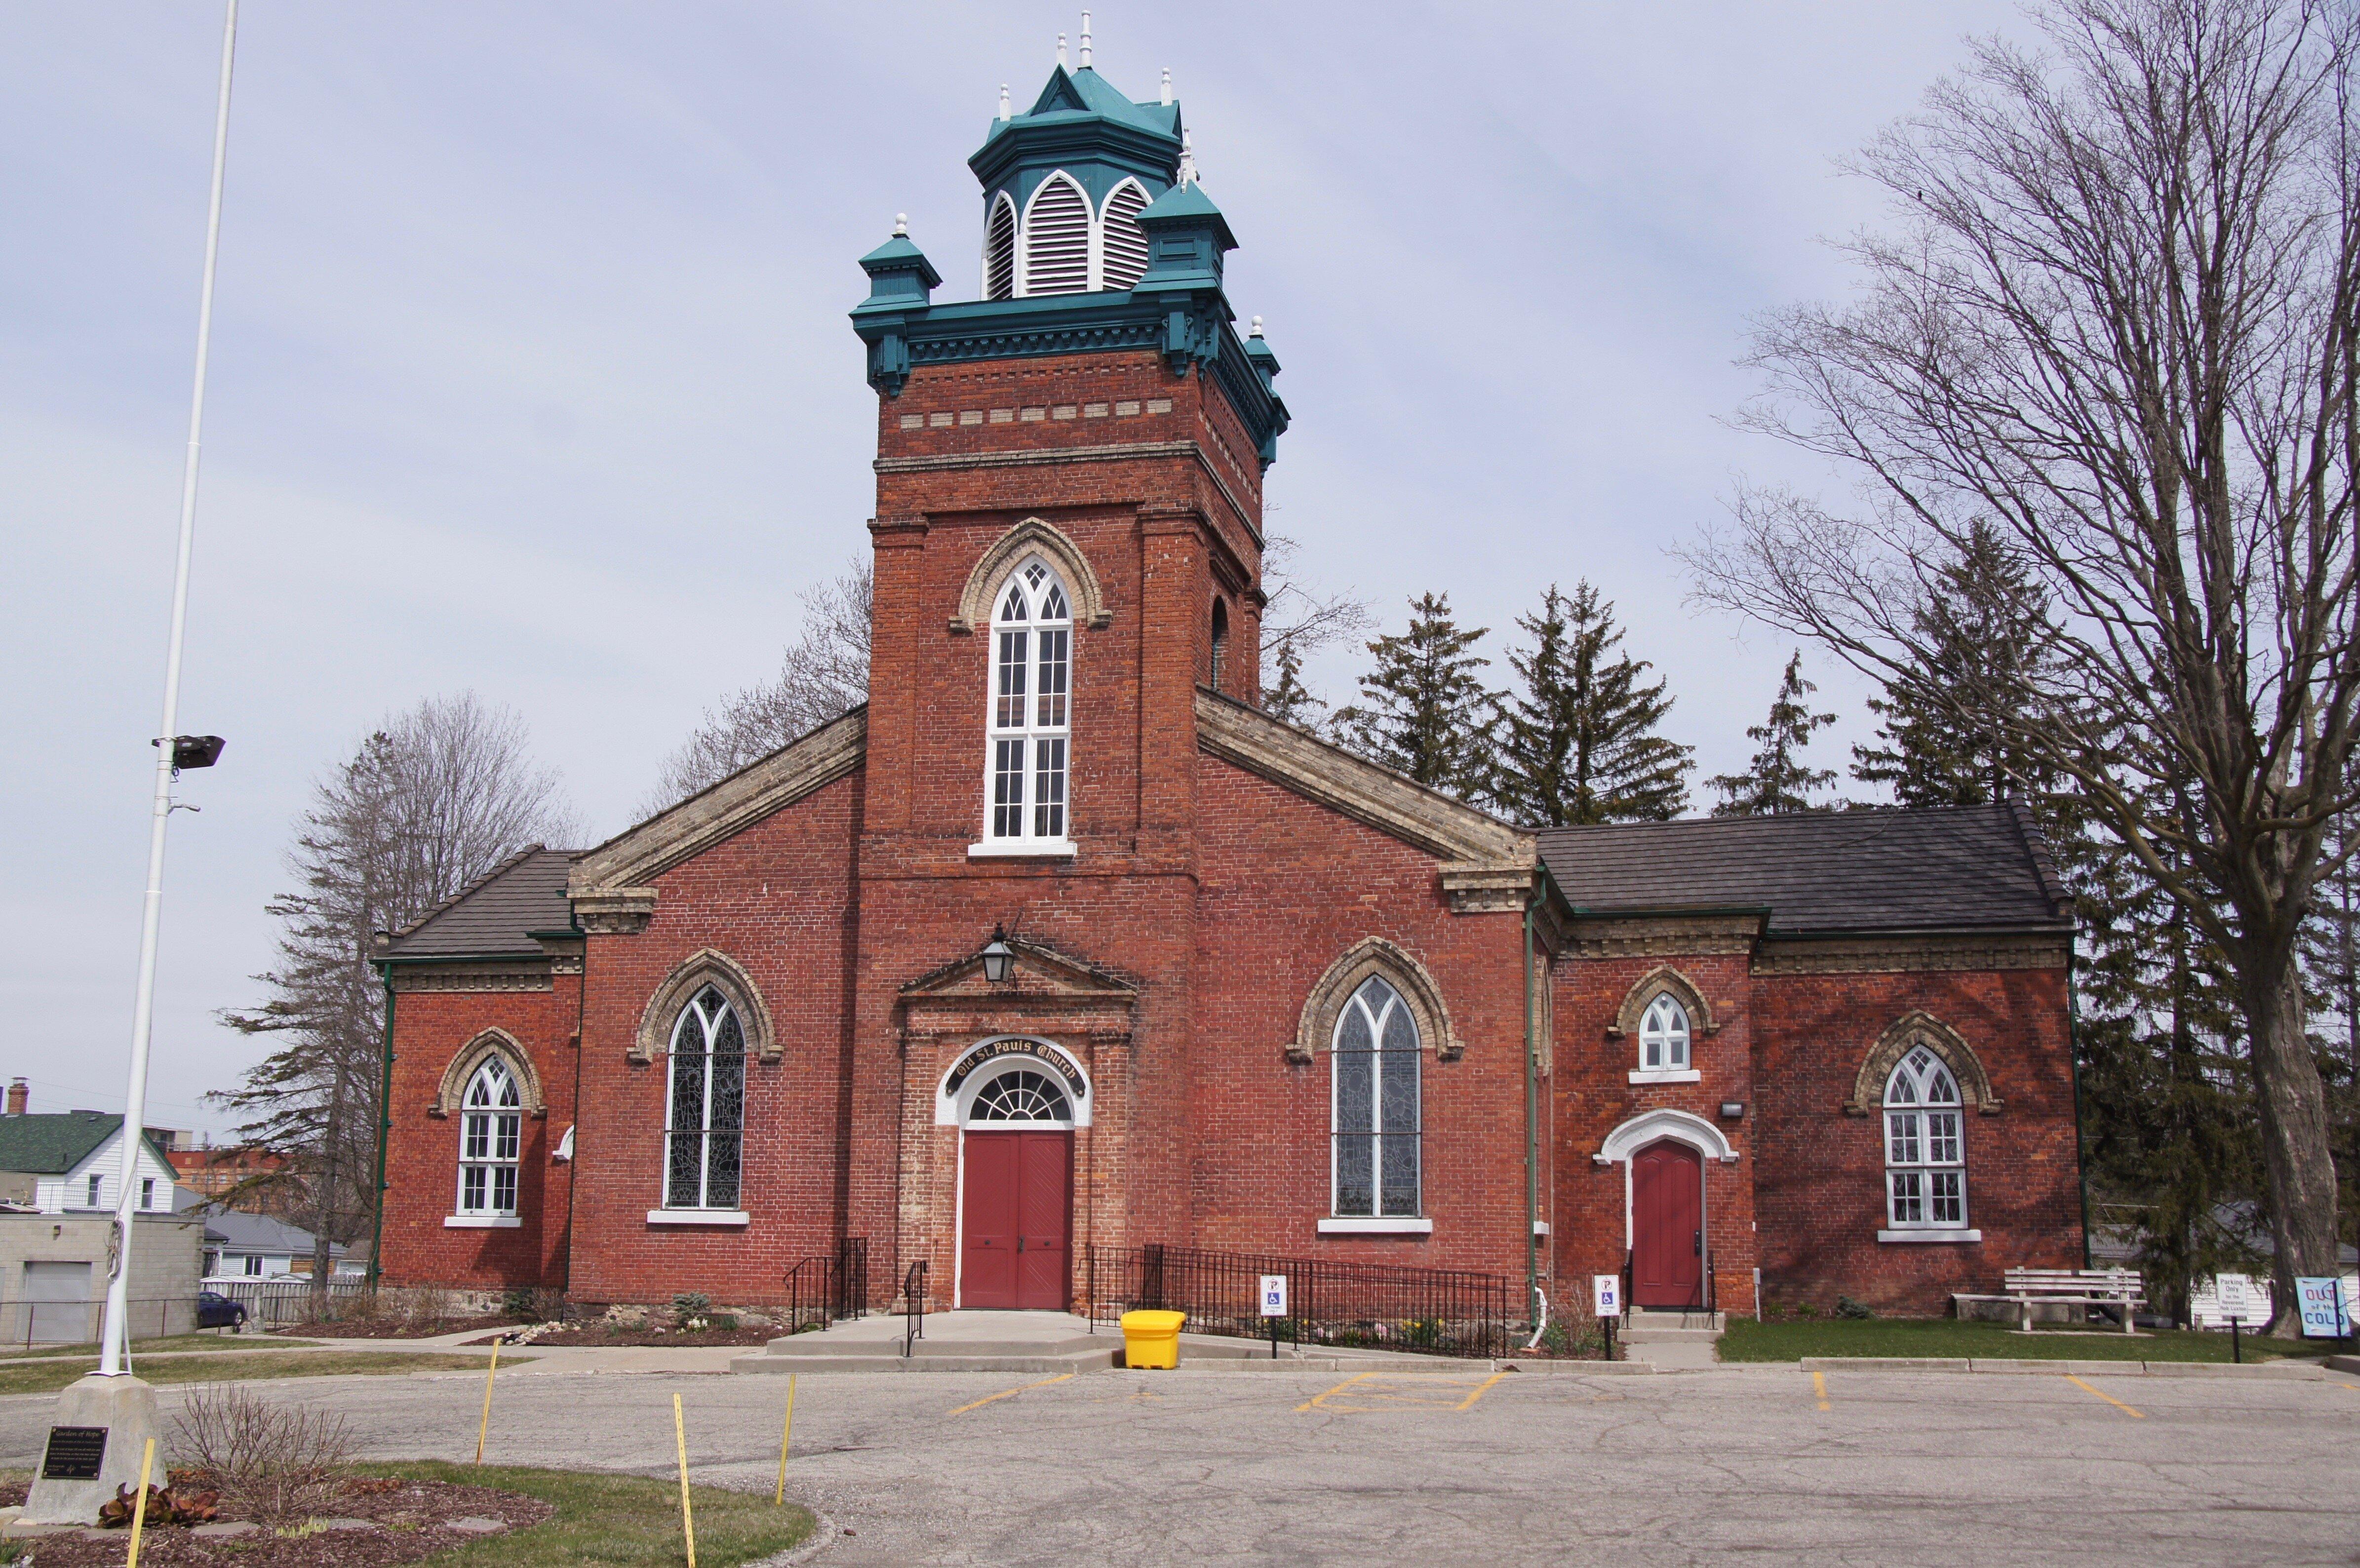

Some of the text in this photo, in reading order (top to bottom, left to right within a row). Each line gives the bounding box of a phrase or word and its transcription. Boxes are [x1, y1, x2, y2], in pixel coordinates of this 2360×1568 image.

[957, 1060, 976, 1076] Old
[976, 1048, 993, 1061] St.
[1037, 1045, 1076, 1079] Church
[2305, 1289, 2334, 1301] OUT
[2304, 1312, 2345, 1325] COLD
